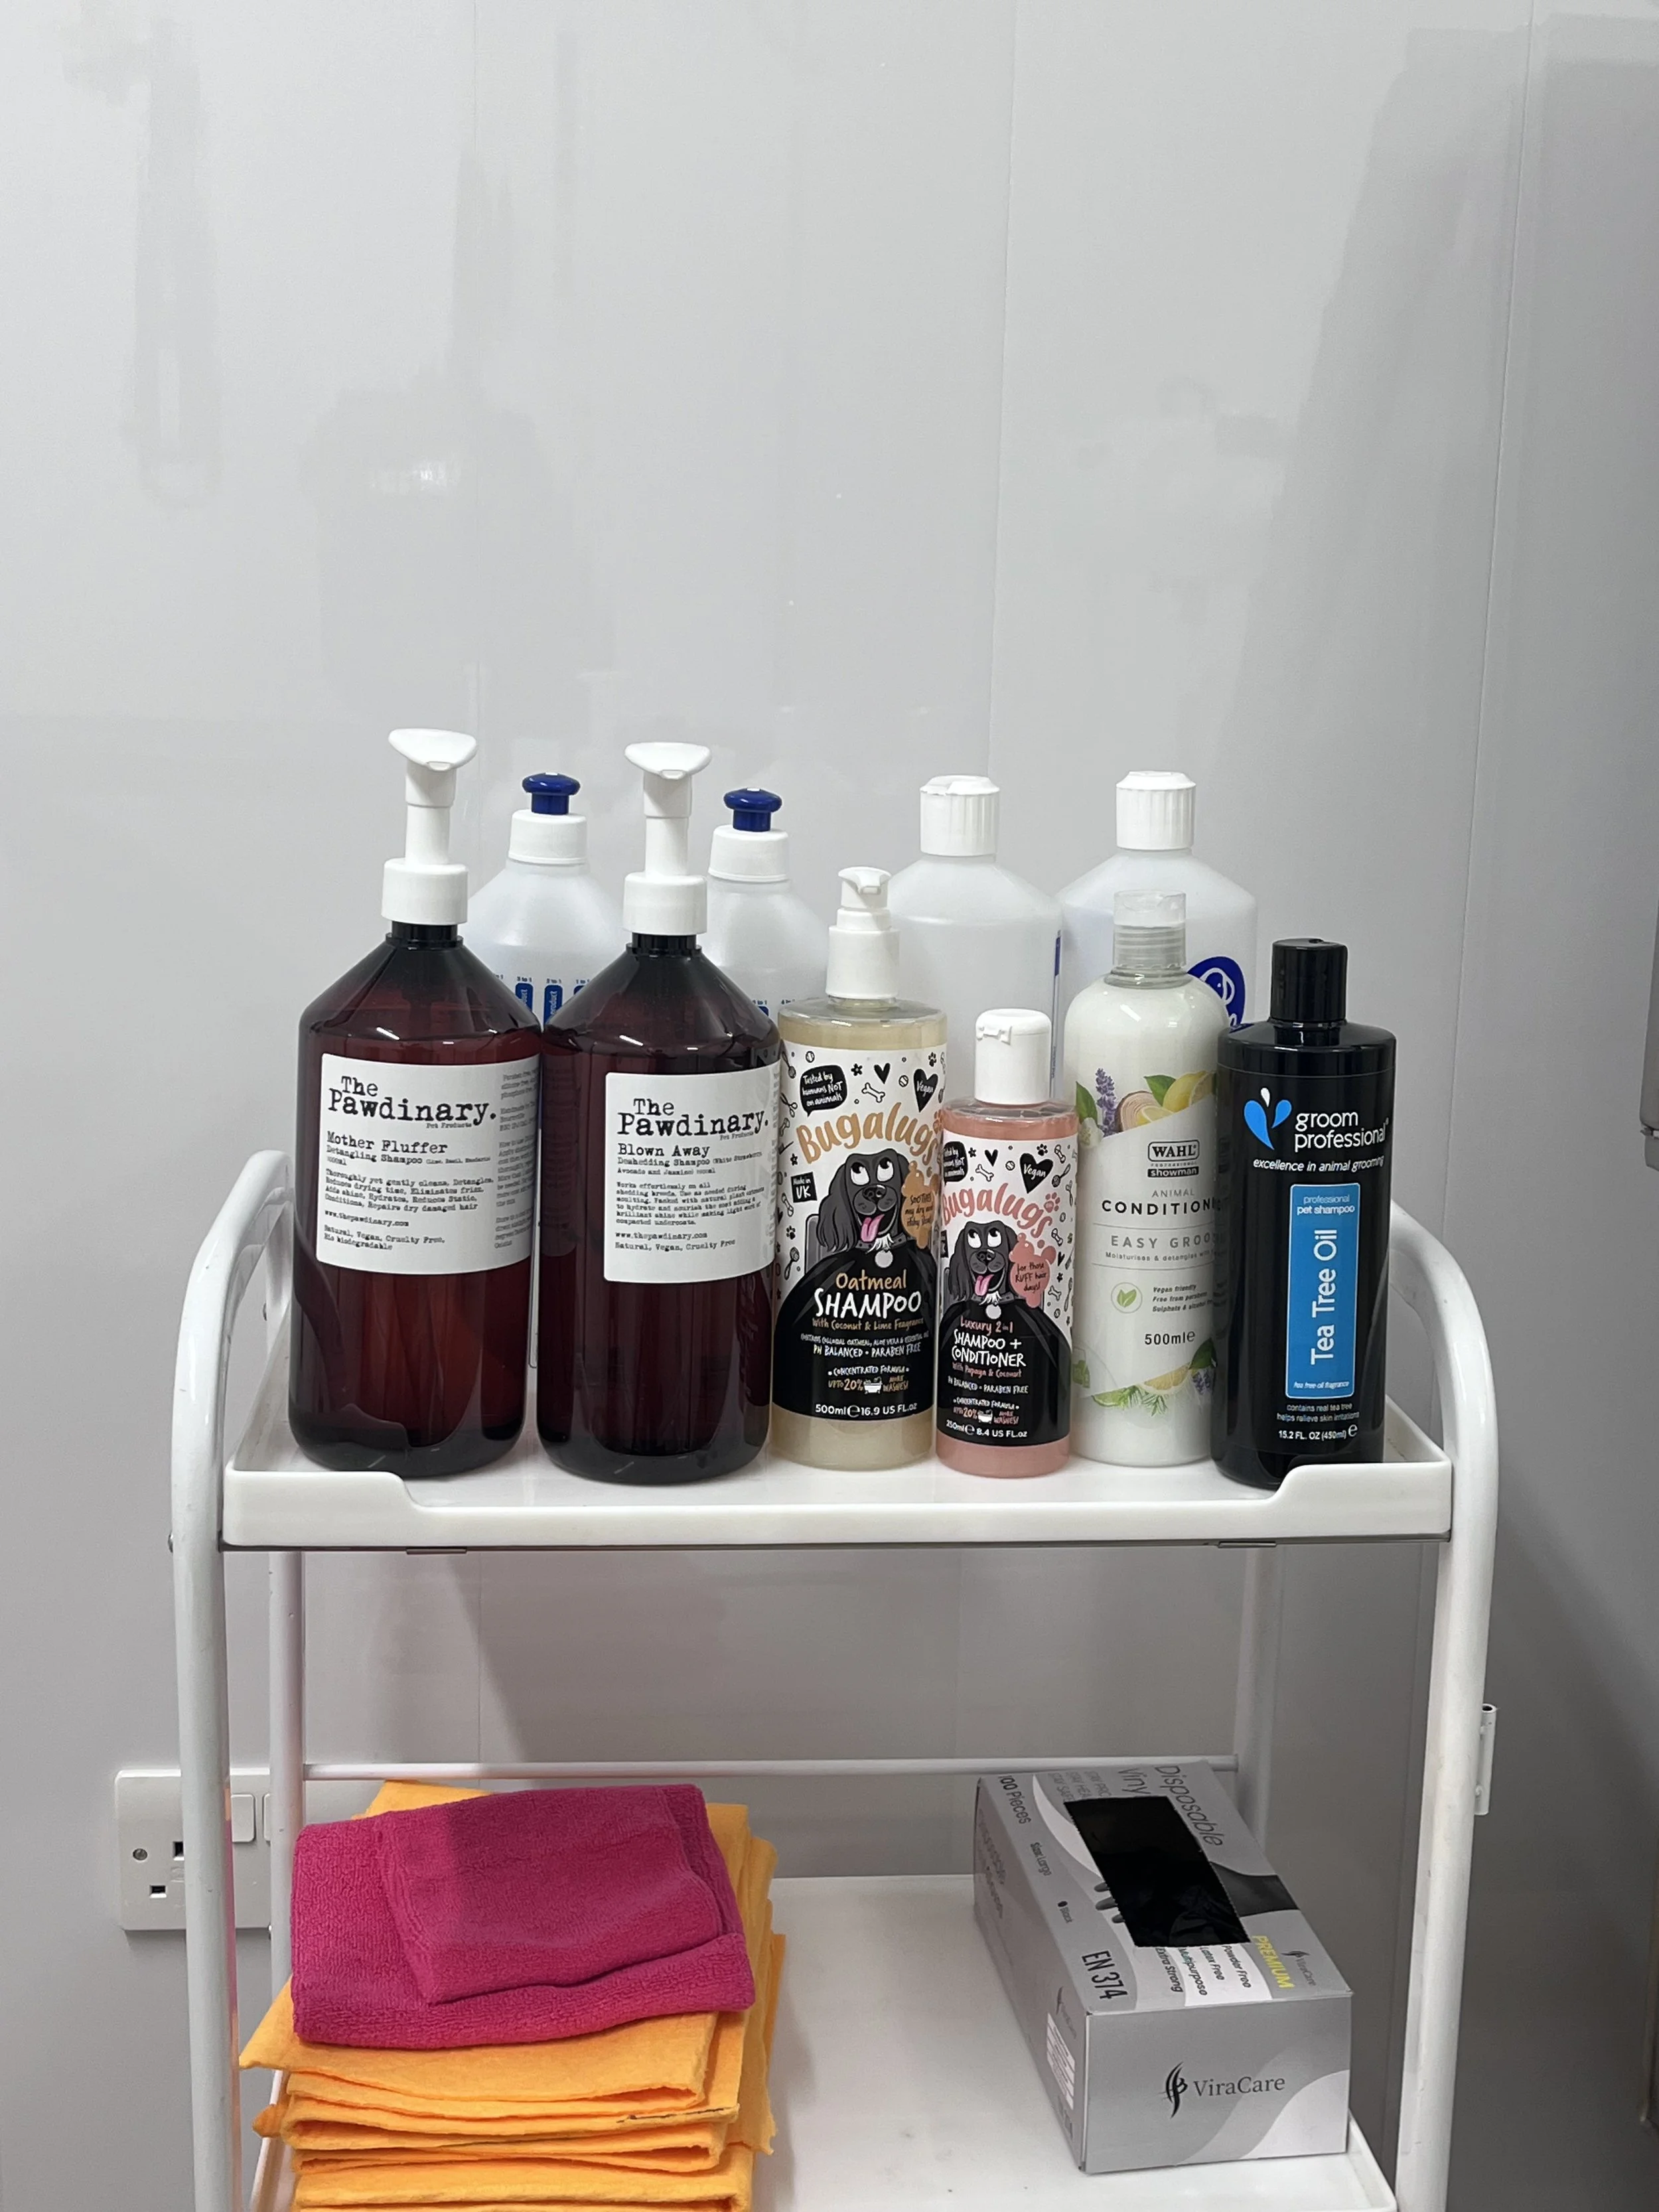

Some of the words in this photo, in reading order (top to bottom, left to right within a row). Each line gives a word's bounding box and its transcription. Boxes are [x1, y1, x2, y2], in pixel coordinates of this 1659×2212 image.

[341, 1075, 378, 1096] The
[802, 1073, 823, 1085] Tested
[823, 1071, 833, 1082] by
[916, 1080, 934, 1097] Vegan
[328, 1088, 496, 1126] Pawdinary.
[633, 1098, 674, 1116] The
[616, 1110, 768, 1137] Pawdinary.
[1295, 1112, 1358, 1132] groom
[327, 1131, 374, 1149] Mother
[382, 1140, 448, 1154] Fluffer
[796, 1102, 938, 1165] Bugalugs
[1294, 1124, 1386, 1153] professional
[326, 1145, 377, 1162] Detangling
[381, 1154, 423, 1165] Shampoo
[617, 1143, 664, 1156] Blown
[672, 1145, 710, 1158] Away
[1151, 1144, 1196, 1157] WAHL
[674, 1159, 710, 1167] Shampoo
[1023, 1163, 1046, 1180] Vegan
[1151, 1167, 1197, 1177] showman
[1253, 1158, 1305, 1171] excellence
[1307, 1161, 1316, 1172] in
[1319, 1160, 1351, 1172] animal
[1351, 1155, 1385, 1173] grooming
[796, 1184, 812, 1199] UK
[1151, 1189, 1194, 1198] ANIMAL
[1303, 1195, 1350, 1205] professional
[942, 1183, 1052, 1238] Bugalugs
[1297, 1206, 1313, 1216] pet
[1313, 1205, 1355, 1215] shampoo
[1111, 1235, 1158, 1249] EASY
[1169, 1232, 1215, 1248] GROO
[1313, 1229, 1338, 1261] Oil
[1029, 1262, 1045, 1270] those
[835, 1268, 907, 1291] Oatmeal
[1015, 1273, 1033, 1283] RUFF
[1311, 1268, 1336, 1318] Tree
[814, 1288, 922, 1319] SHAMPOO
[831, 1319, 862, 1331] Coconut
[873, 1319, 892, 1330] Lime
[960, 1315, 992, 1337] Luxury
[954, 1328, 1006, 1350] SHAMPOO
[1009, 1339, 1022, 1349] +
[1311, 1324, 1335, 1365] Tea
[824, 1345, 863, 1358] BALANCED
[871, 1346, 904, 1358] PARABEN
[906, 1342, 921, 1355] FREE
[952, 1345, 1027, 1367] CONDITIONER
[965, 1364, 986, 1378] Papaya
[988, 1368, 994, 1377] &
[996, 1368, 1022, 1378] Coconut
[843, 1378, 863, 1391] 20%
[983, 1384, 1011, 1394] PARABEN
[1013, 1385, 1029, 1394] FREE
[883, 1406, 895, 1414] US
[1277, 1412, 1295, 1422] helps
[976, 1428, 989, 1436] 8.4
[1278, 1430, 1294, 1439] 15.2
[1309, 1431, 1321, 1439] OZ
[998, 1775, 1018, 1791] 100
[1007, 1790, 1031, 1824] Pieces
[1155, 1765, 1224, 1846] Disposable
[1081, 1950, 1114, 1972] EN
[1155, 1947, 1170, 1966] Extra
[1166, 1965, 1183, 1993] Strong
[1199, 1947, 1216, 1964] Latex
[1212, 1963, 1226, 1981] Free
[1222, 1945, 1242, 1970] Powder
[1237, 1968, 1252, 1988] Free
[1252, 1935, 1295, 1990] PREMIUM
[1178, 1948, 1208, 1997] Multipurpose
[1295, 1957, 1317, 1987] ViraCare
[1092, 1970, 1128, 2000] 374
[1192, 2075, 1285, 2097] ViraCare
